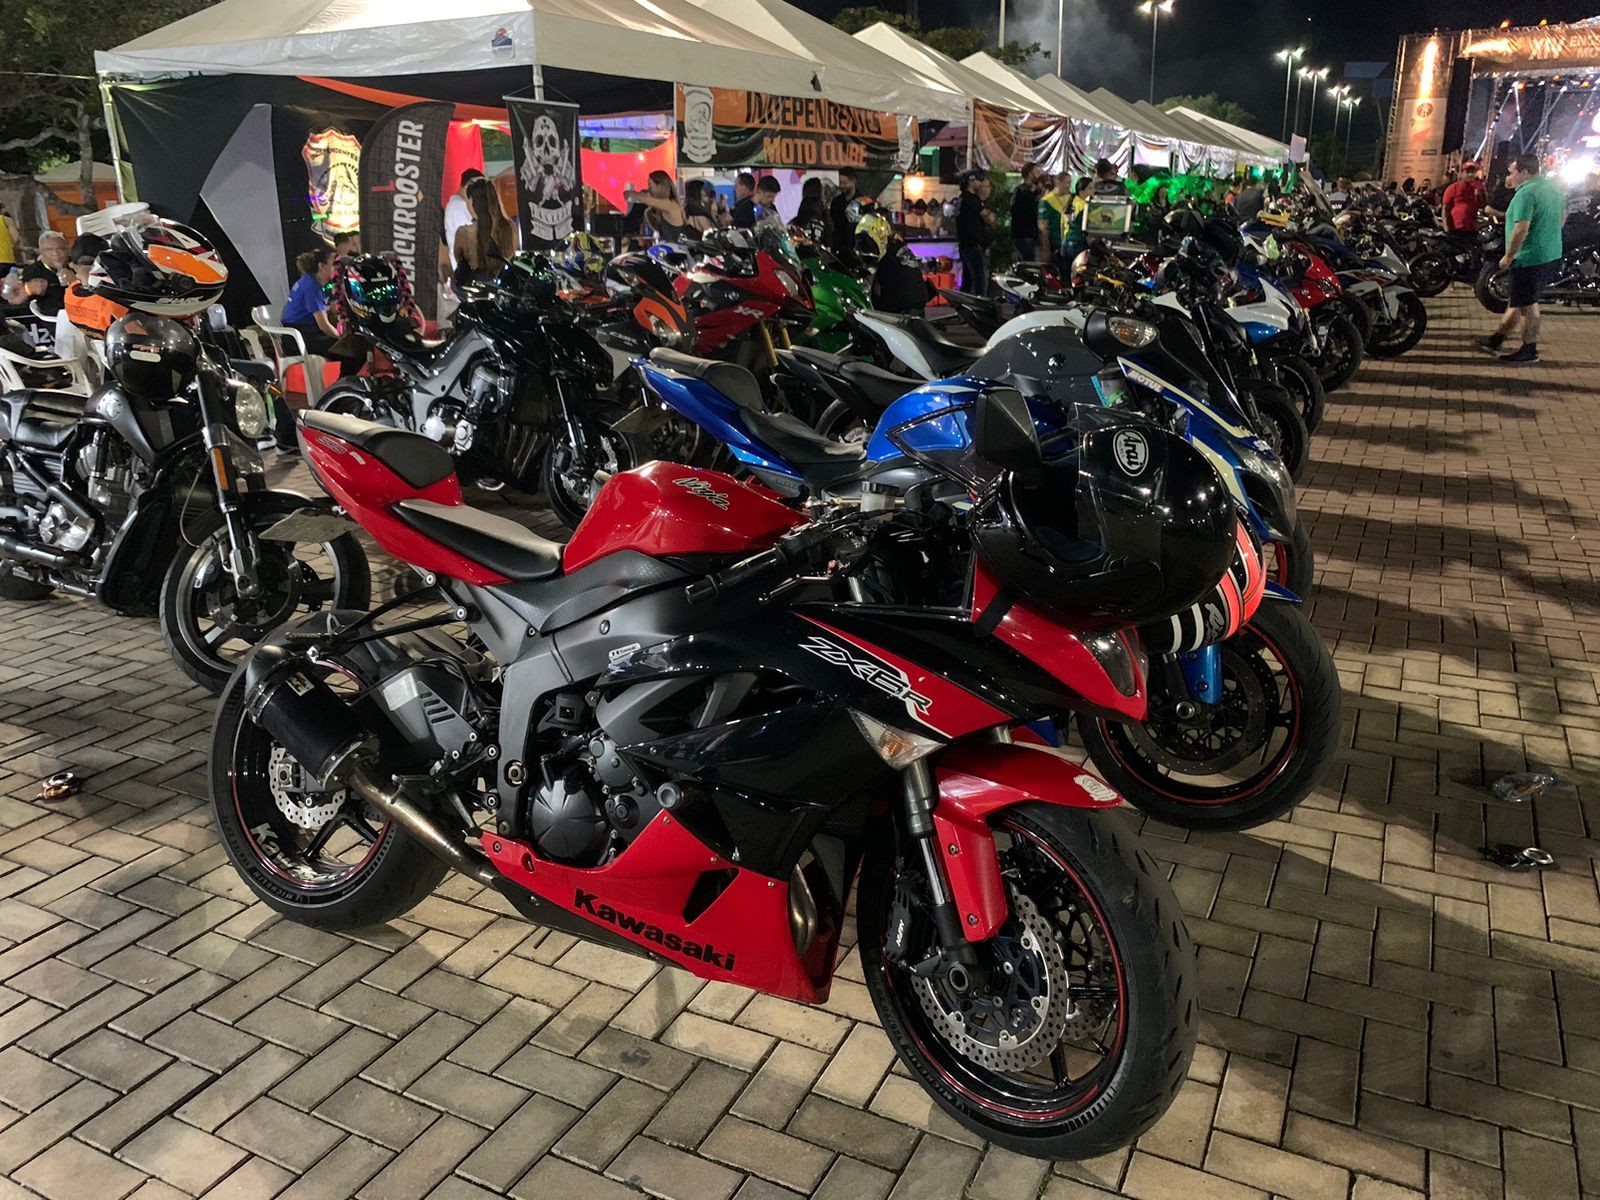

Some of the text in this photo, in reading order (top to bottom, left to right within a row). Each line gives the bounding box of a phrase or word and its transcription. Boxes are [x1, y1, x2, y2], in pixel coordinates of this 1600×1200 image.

[763, 136, 817, 165] MOTO
[393, 120, 424, 296] LACKROOSTER
[1121, 432, 1144, 467] Arai
[672, 477, 730, 511] Ninja
[574, 888, 736, 972] Kawasaki
